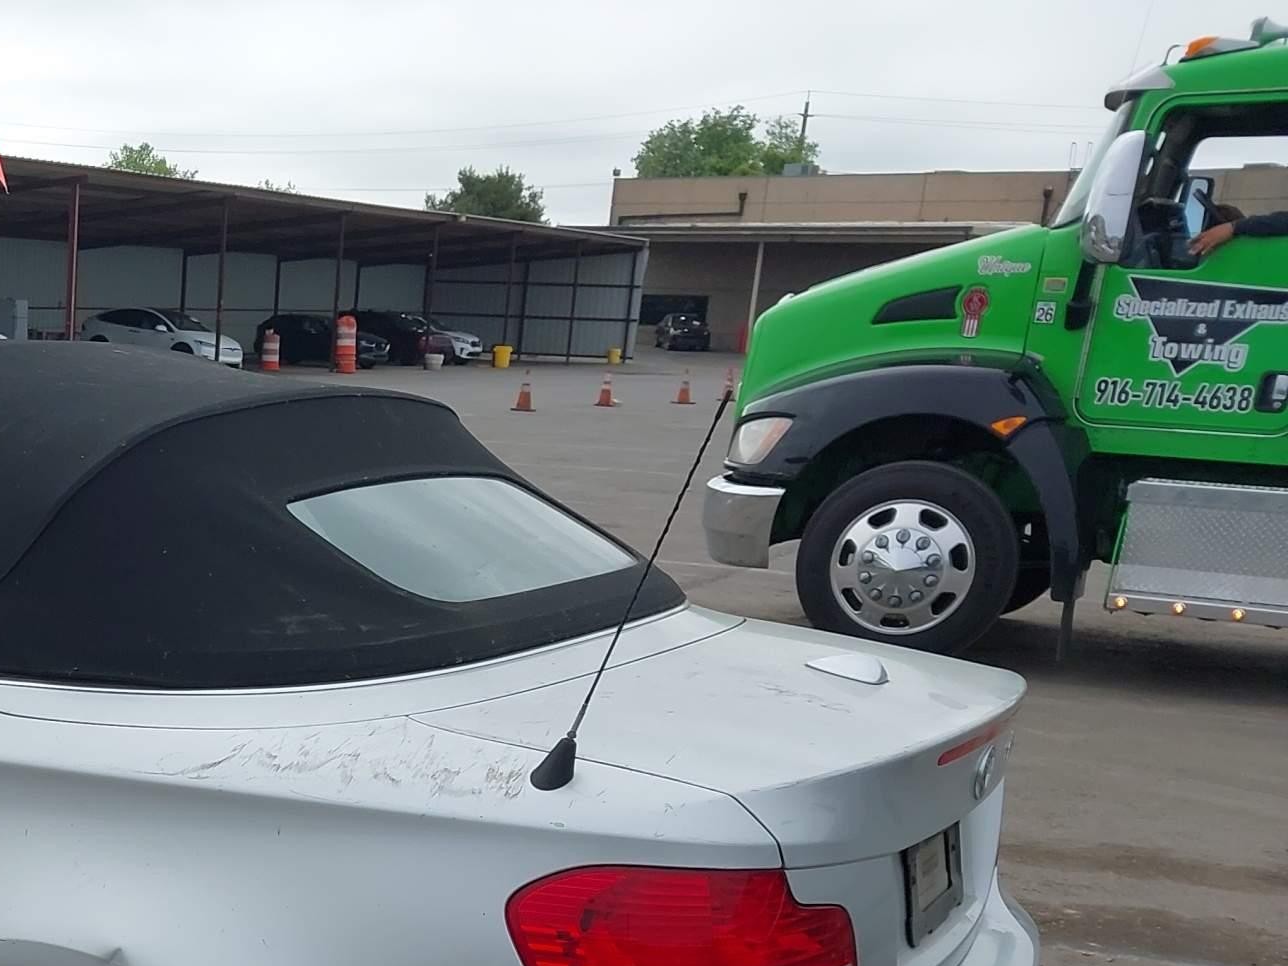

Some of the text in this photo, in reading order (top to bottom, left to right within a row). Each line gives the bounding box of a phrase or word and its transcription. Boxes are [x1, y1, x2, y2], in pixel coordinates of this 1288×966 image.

[1036, 307, 1054, 322] 26
[1115, 296, 1221, 320] Specialized
[1196, 323, 1207, 335] &
[1150, 336, 1248, 371] Towing
[1095, 378, 1255, 413] 916-714-4638
